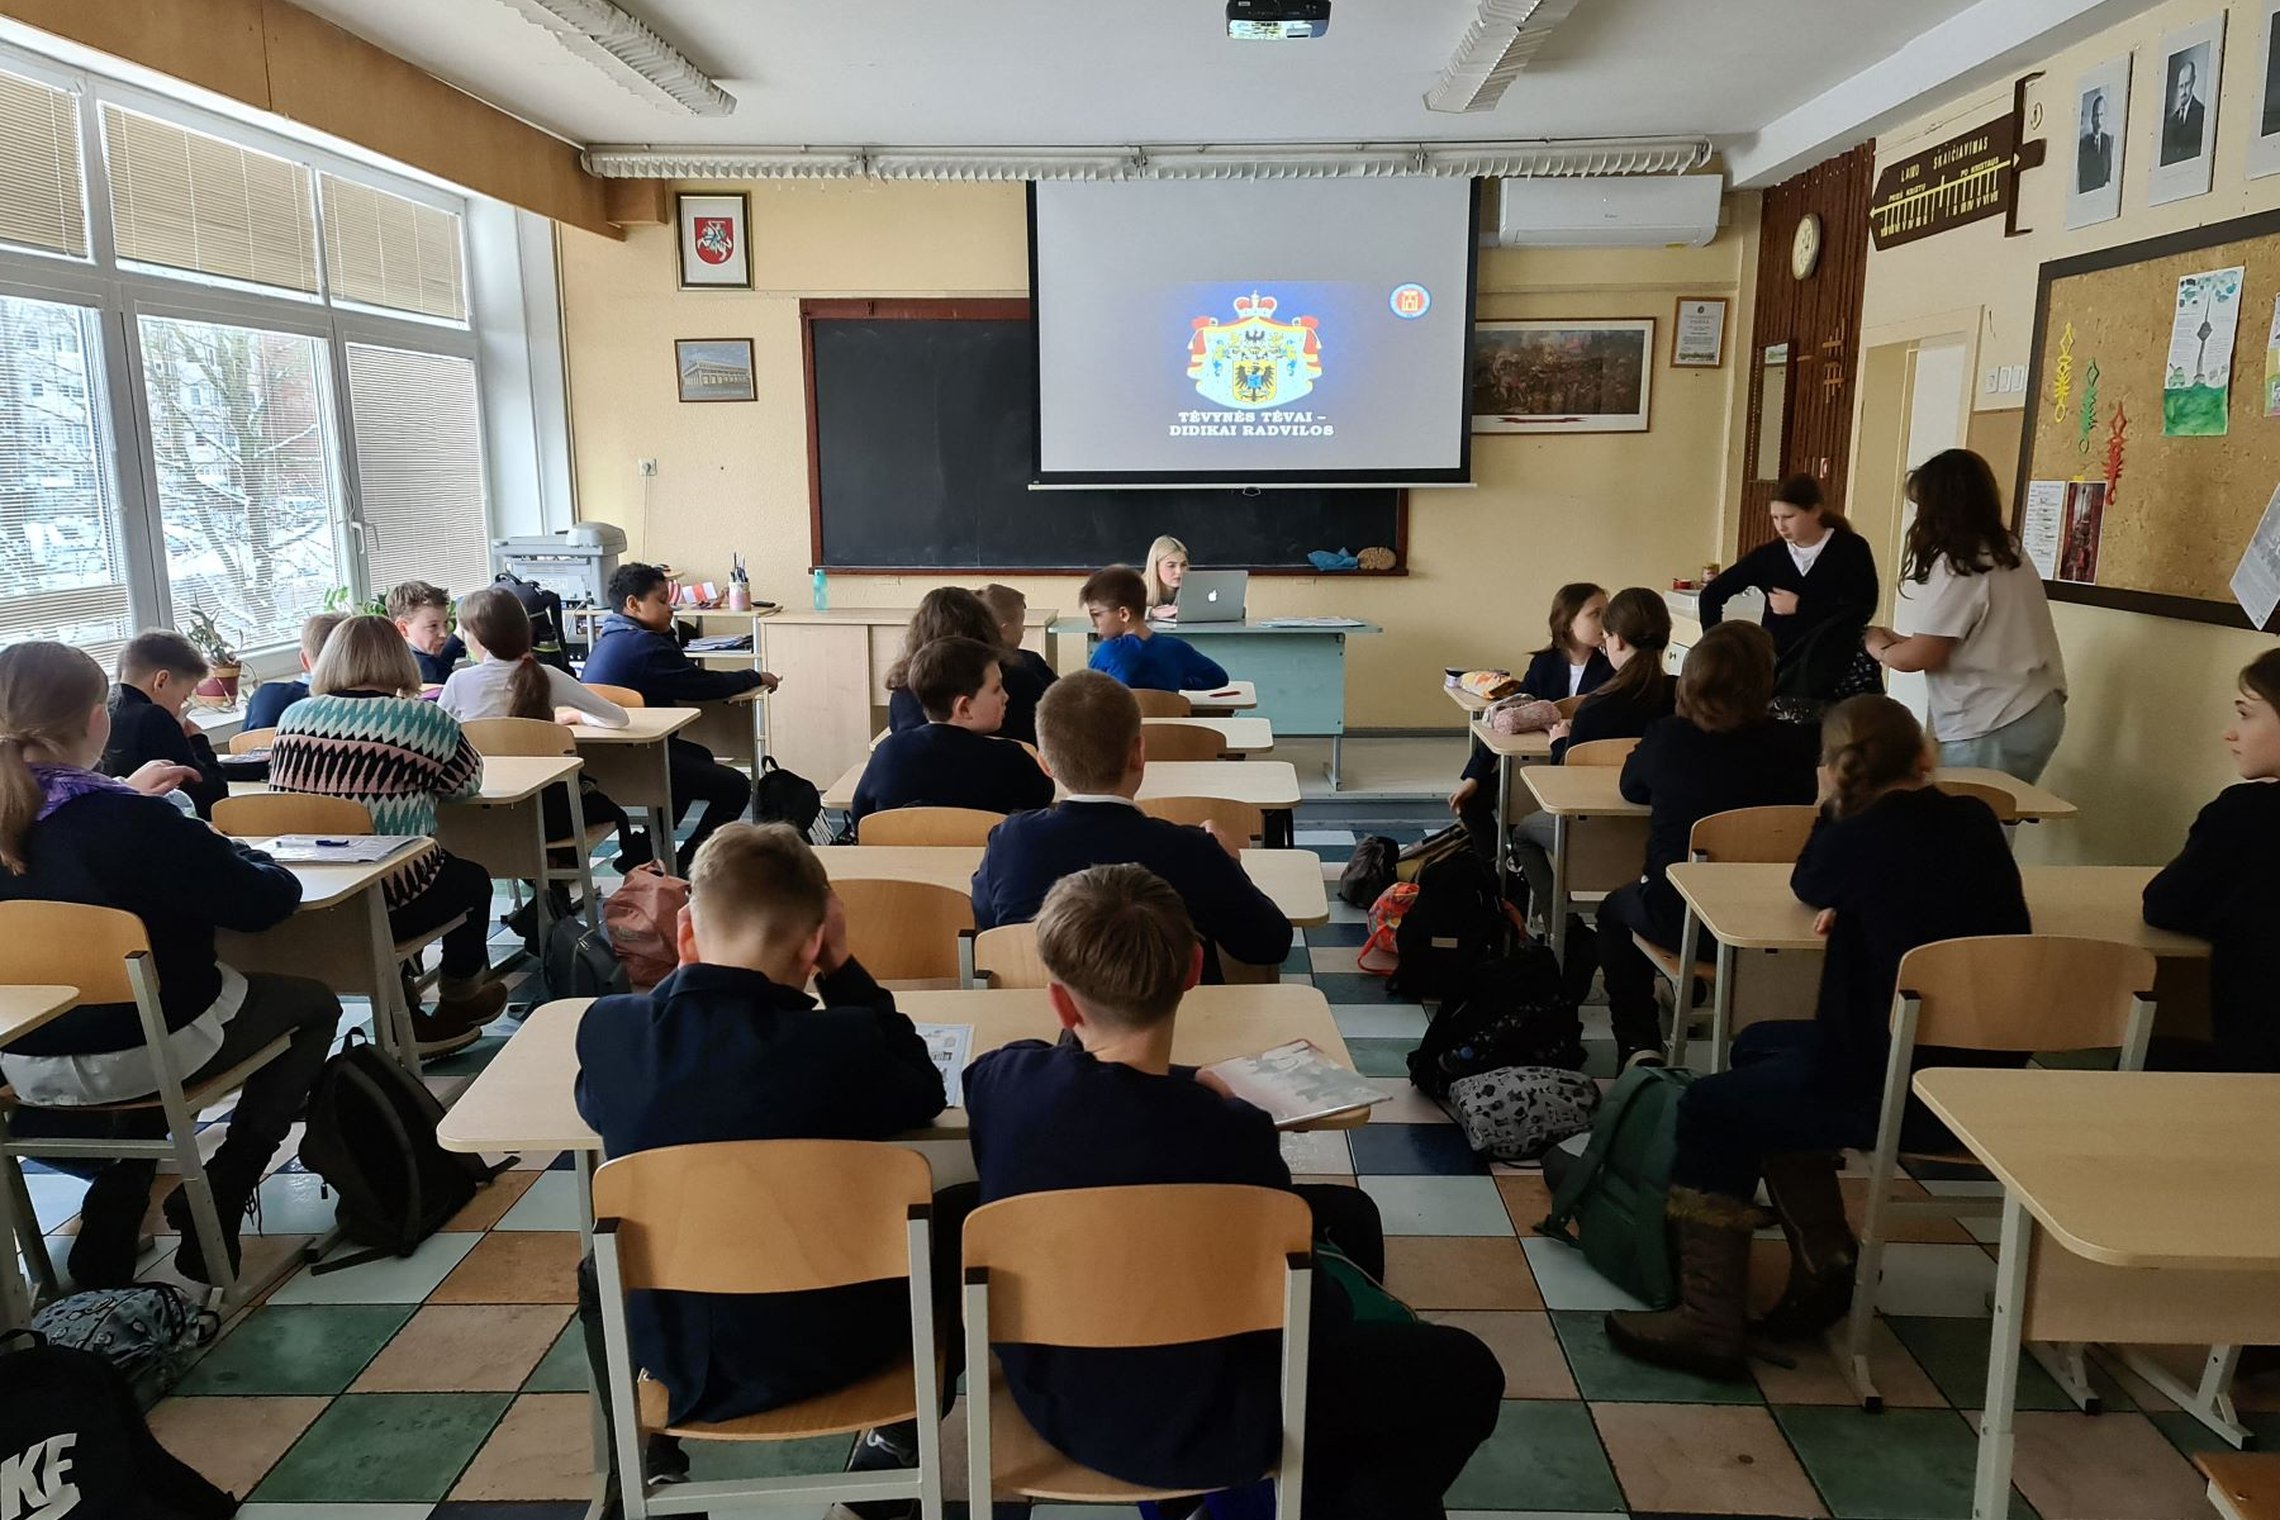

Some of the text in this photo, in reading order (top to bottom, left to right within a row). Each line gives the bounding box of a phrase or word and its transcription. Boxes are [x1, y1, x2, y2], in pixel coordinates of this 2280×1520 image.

[1933, 136, 1989, 170] SKAIČIAVIMAS
[1178, 410, 1255, 423] TĖVYNĖS
[1261, 410, 1313, 423] TĖVAI
[1169, 425, 1334, 436] DIDIKAI RADVILOS
